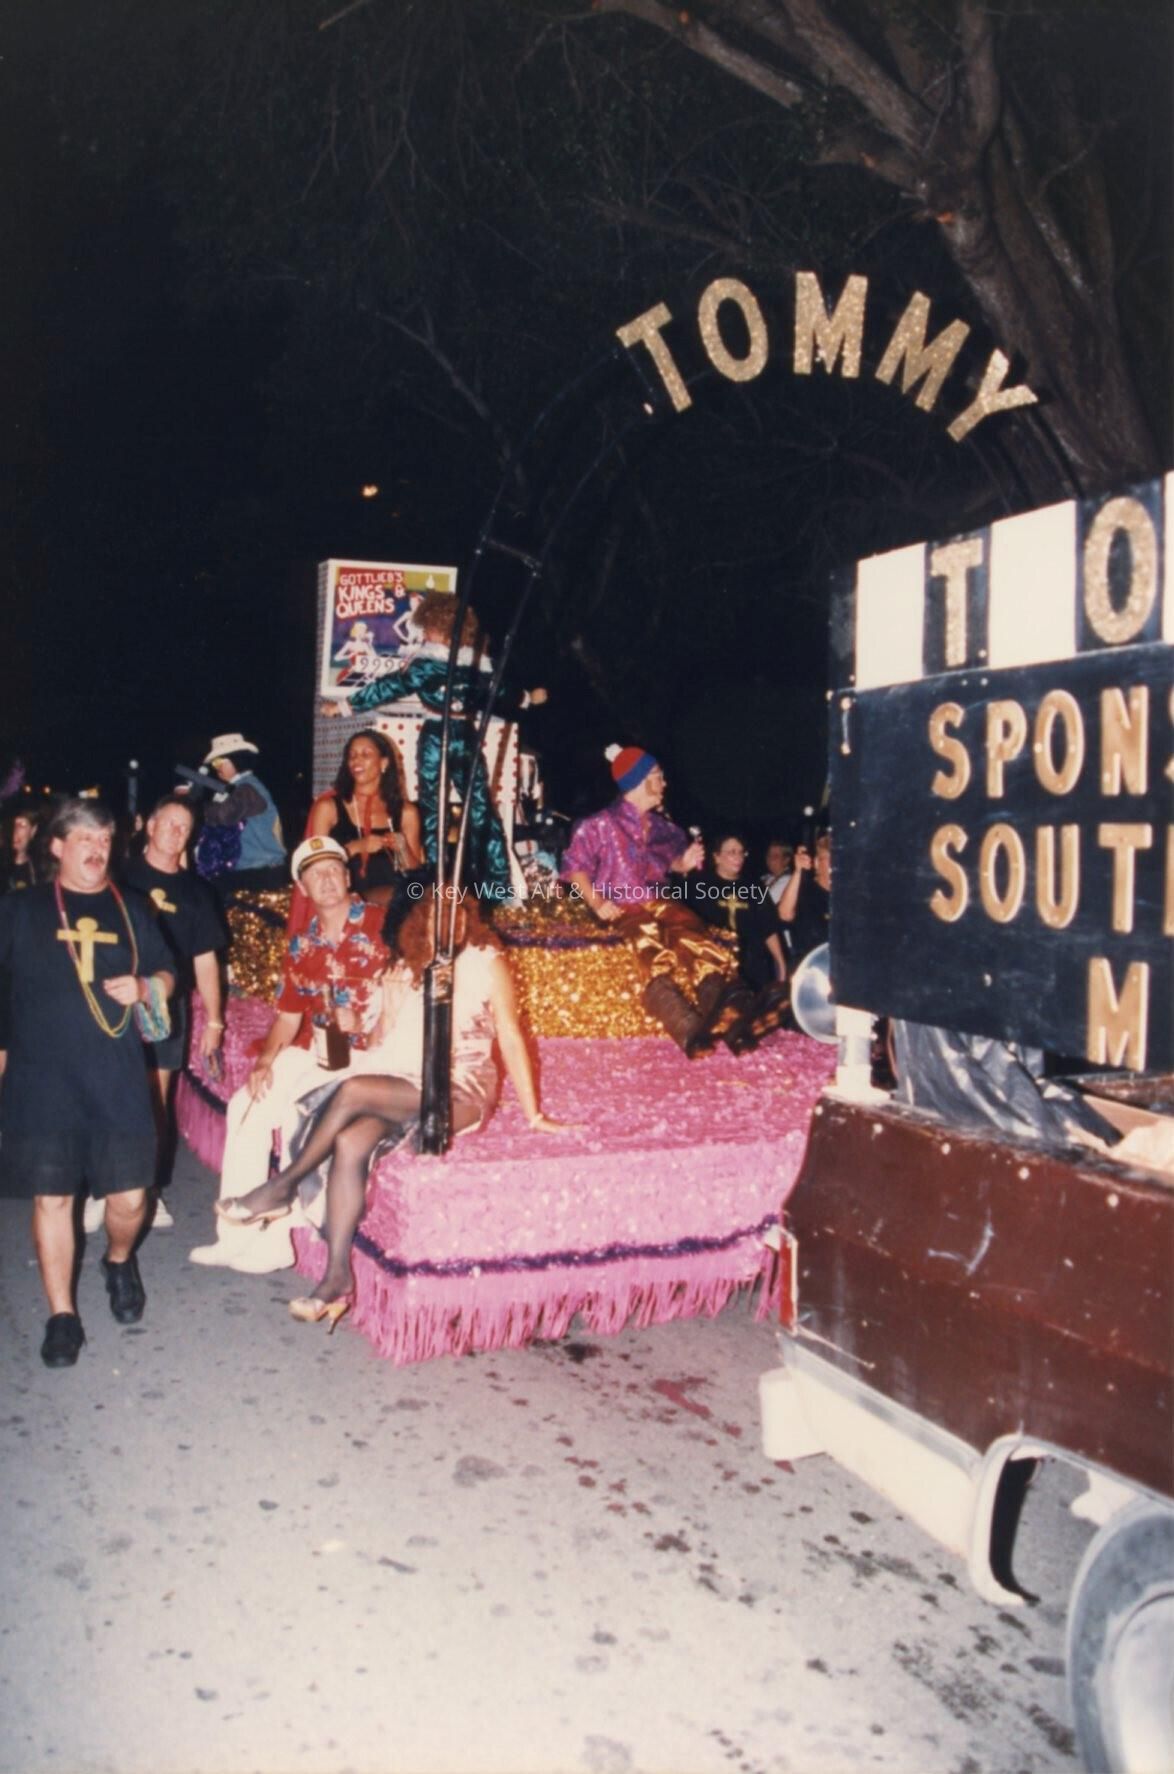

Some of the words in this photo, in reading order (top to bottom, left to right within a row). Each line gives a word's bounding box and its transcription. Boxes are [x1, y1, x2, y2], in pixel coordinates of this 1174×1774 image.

[616, 271, 1038, 443] TOMMY
[336, 597, 395, 619] QUEENS
[338, 584, 385, 601] KINGS
[928, 684, 1174, 800] SPON
[929, 822, 1174, 937] SOUT
